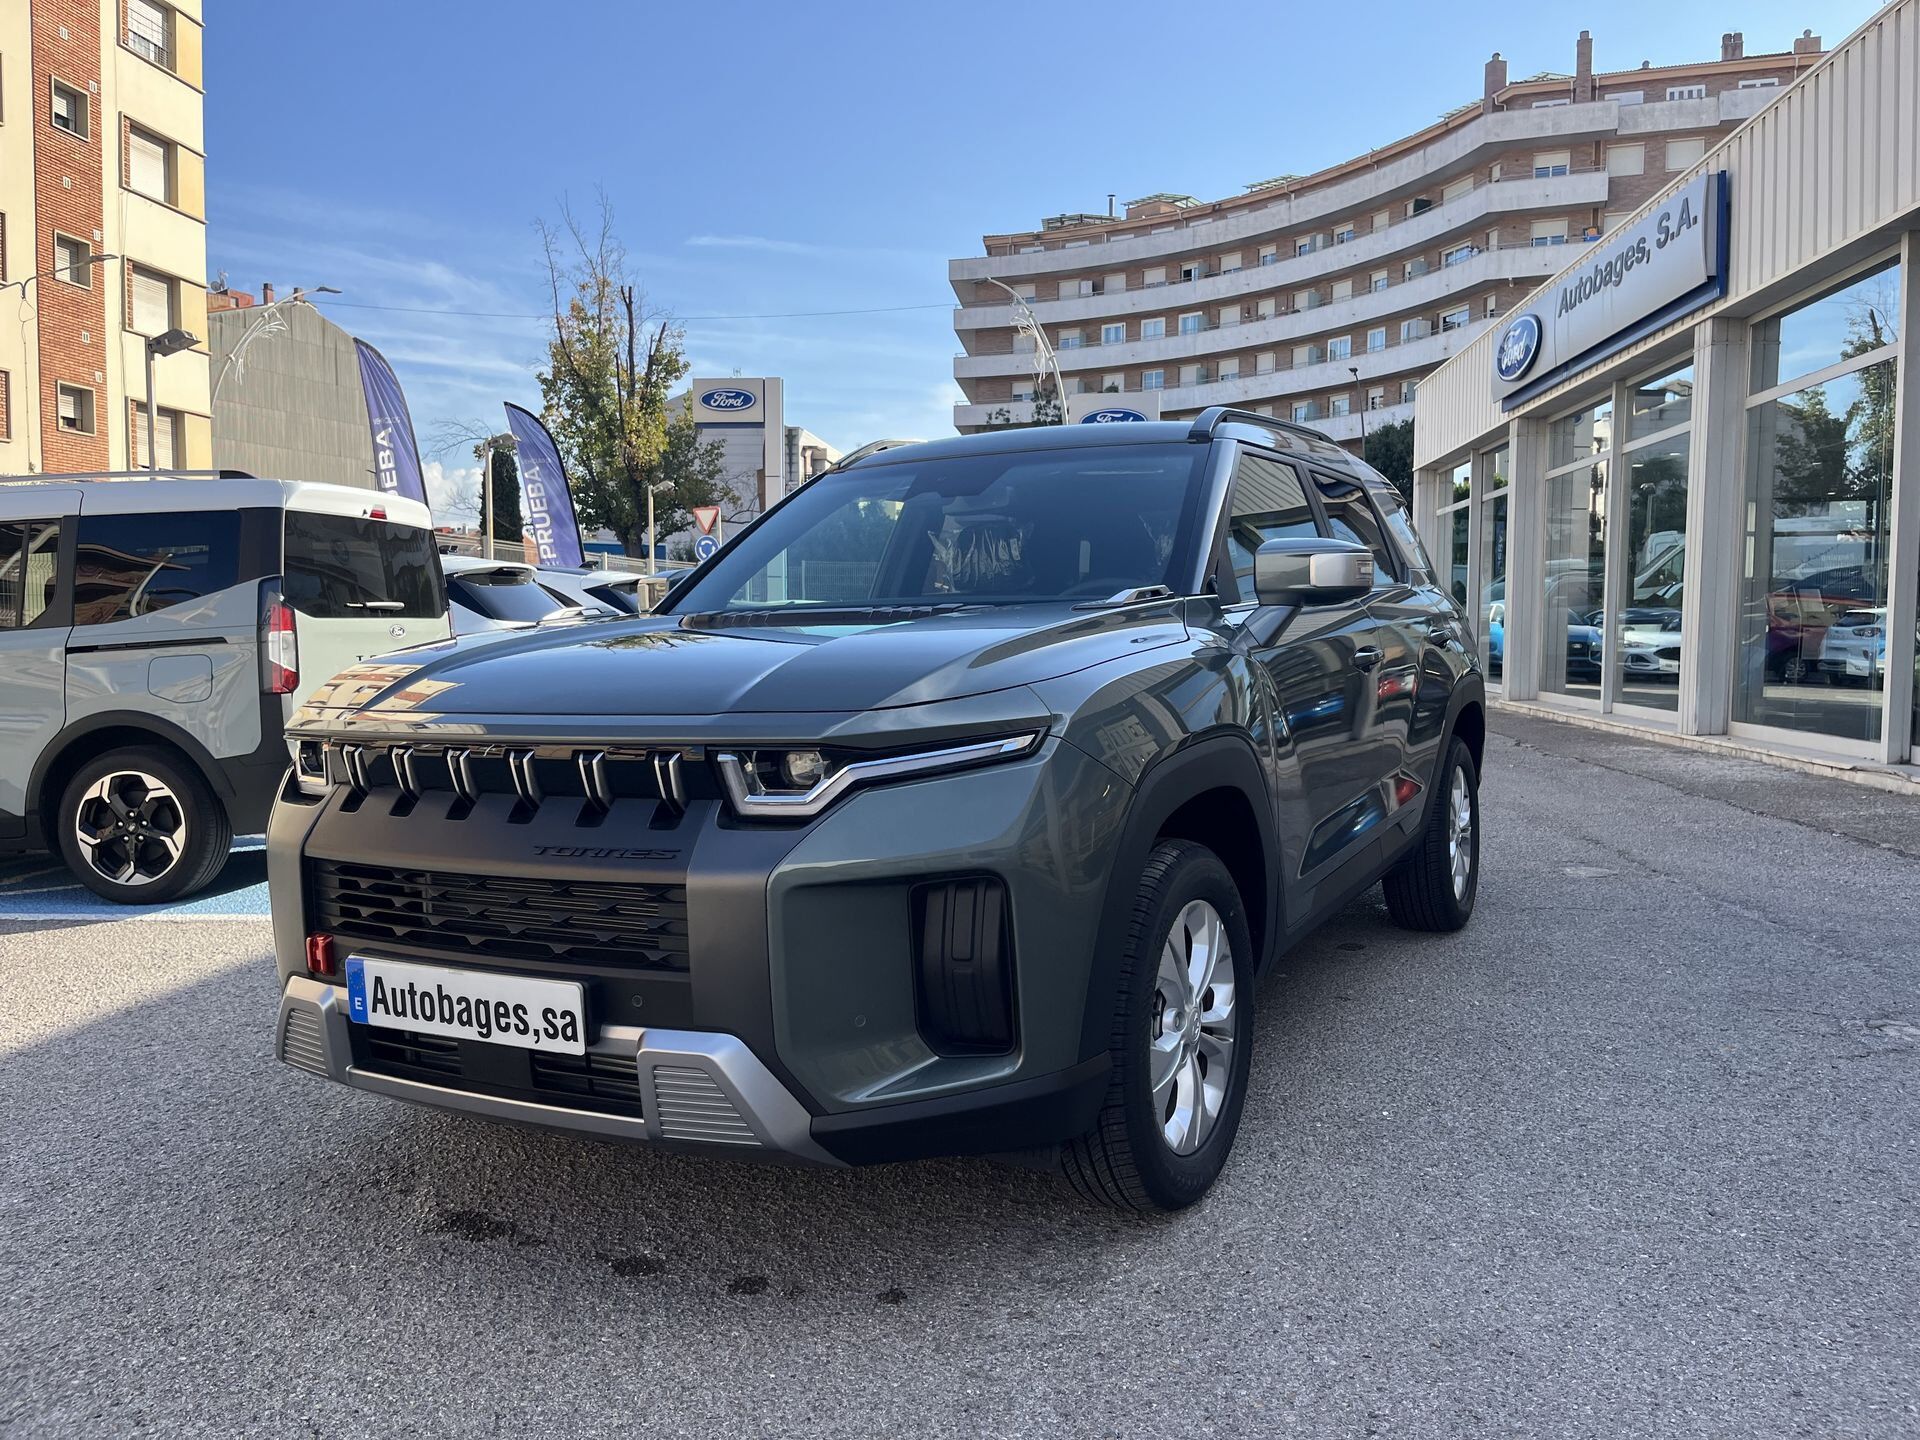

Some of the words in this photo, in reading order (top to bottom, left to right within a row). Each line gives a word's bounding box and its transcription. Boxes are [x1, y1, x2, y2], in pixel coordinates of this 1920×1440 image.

[1558, 237, 1650, 318] Autobages,
[1656, 197, 1698, 249] S.A.
[1502, 326, 1527, 370] Ford
[710, 391, 744, 406] Ford
[376, 427, 399, 496] EBA
[525, 466, 556, 559] PRUEBA
[354, 997, 363, 1010] E
[371, 976, 580, 1044] Autobages,sa
